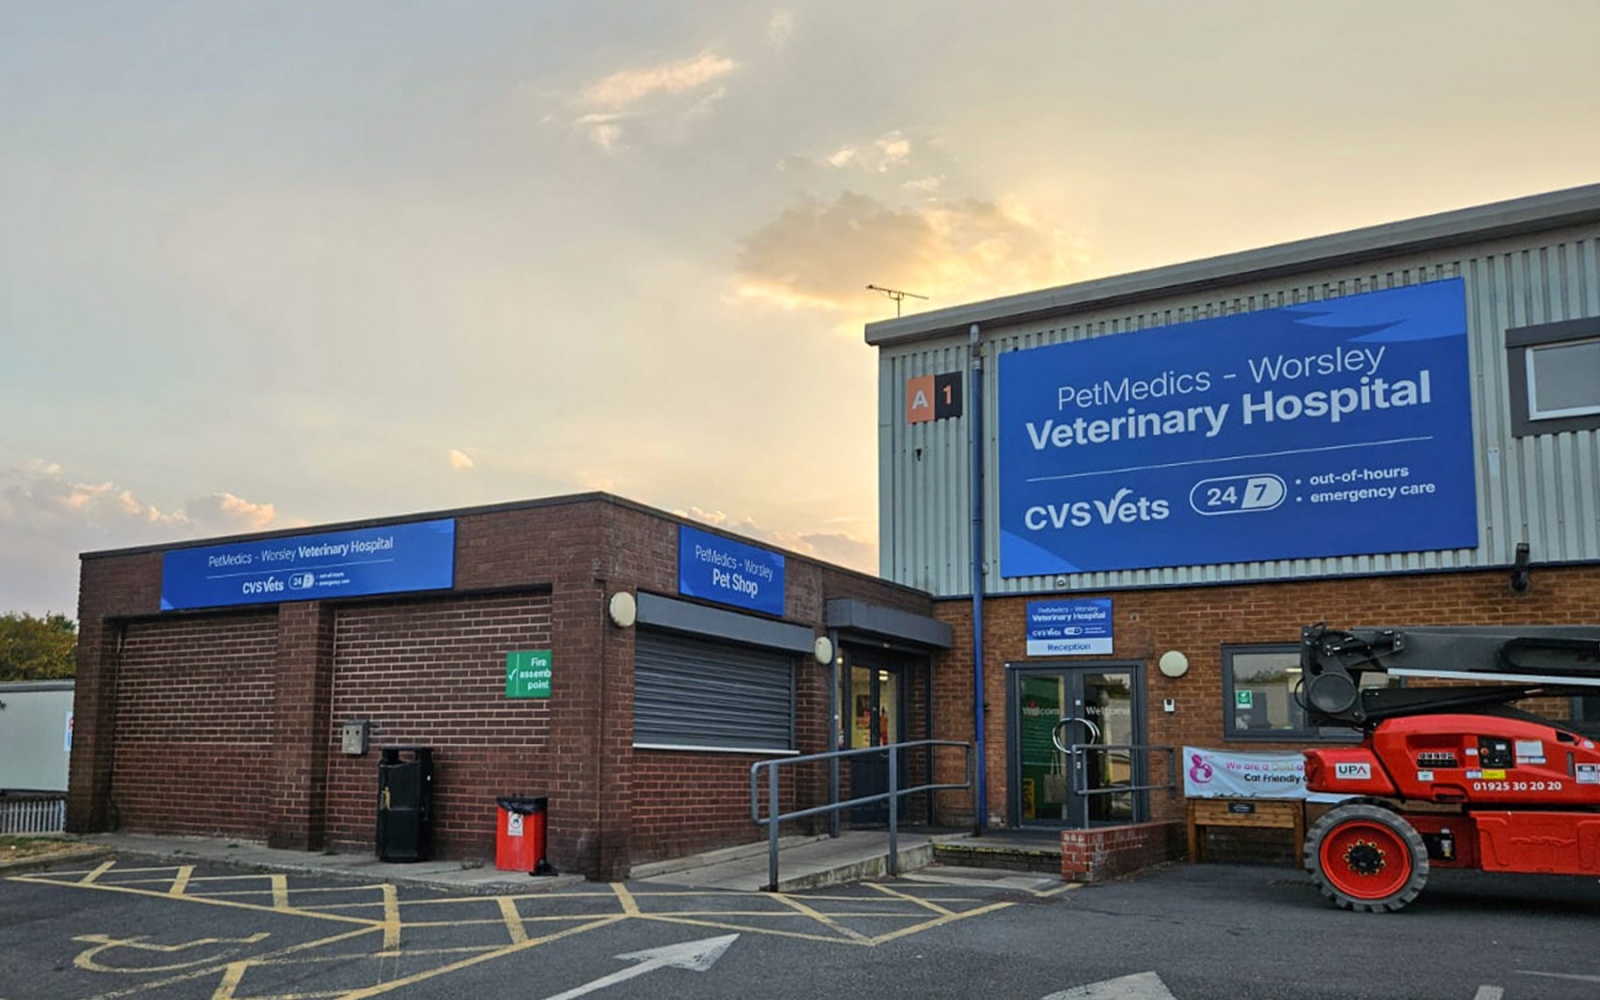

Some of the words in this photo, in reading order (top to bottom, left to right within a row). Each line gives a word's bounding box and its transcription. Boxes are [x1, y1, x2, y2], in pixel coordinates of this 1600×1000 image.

[1058, 370, 1211, 411] PetMedics
[1248, 345, 1386, 384] Worsley
[911, 389, 929, 410] A
[943, 384, 952, 405] 1
[1025, 403, 1230, 450] Veterinary
[1242, 369, 1431, 425] Hospital
[1309, 466, 1410, 486] out-of-hours
[1206, 486, 1238, 506] 24
[1252, 483, 1268, 502] 7
[1310, 484, 1397, 503] emergency
[1400, 481, 1436, 496] care
[1024, 501, 1092, 531] CVS
[1093, 487, 1170, 525] Vets
[208, 552, 252, 568] PetMedics
[261, 548, 298, 563] Worsley
[298, 542, 349, 559] Veterinary
[350, 536, 394, 553] Hospital
[695, 544, 737, 570] PetMedics
[744, 558, 774, 583] Worsley
[242, 581, 262, 594] CVS
[263, 576, 284, 593] Vets
[712, 567, 730, 589] Pet
[732, 573, 758, 599] Shop
[1032, 613, 1072, 622] Veterinary
[1073, 611, 1106, 621] Hospital
[1047, 642, 1091, 652] Reception
[531, 656, 547, 667] Fire
[527, 680, 549, 691] point
[1226, 761, 1242, 771] We
[1244, 763, 1259, 772] are
[1262, 763, 1270, 772] a
[1338, 765, 1367, 775] UPA
[1244, 773, 1261, 783] Cat
[1262, 773, 1301, 785] Friendly
[1473, 781, 1510, 791] 01925
[1512, 781, 1527, 791] 30
[1530, 781, 1545, 791] 20
[1547, 781, 1562, 791] 20
